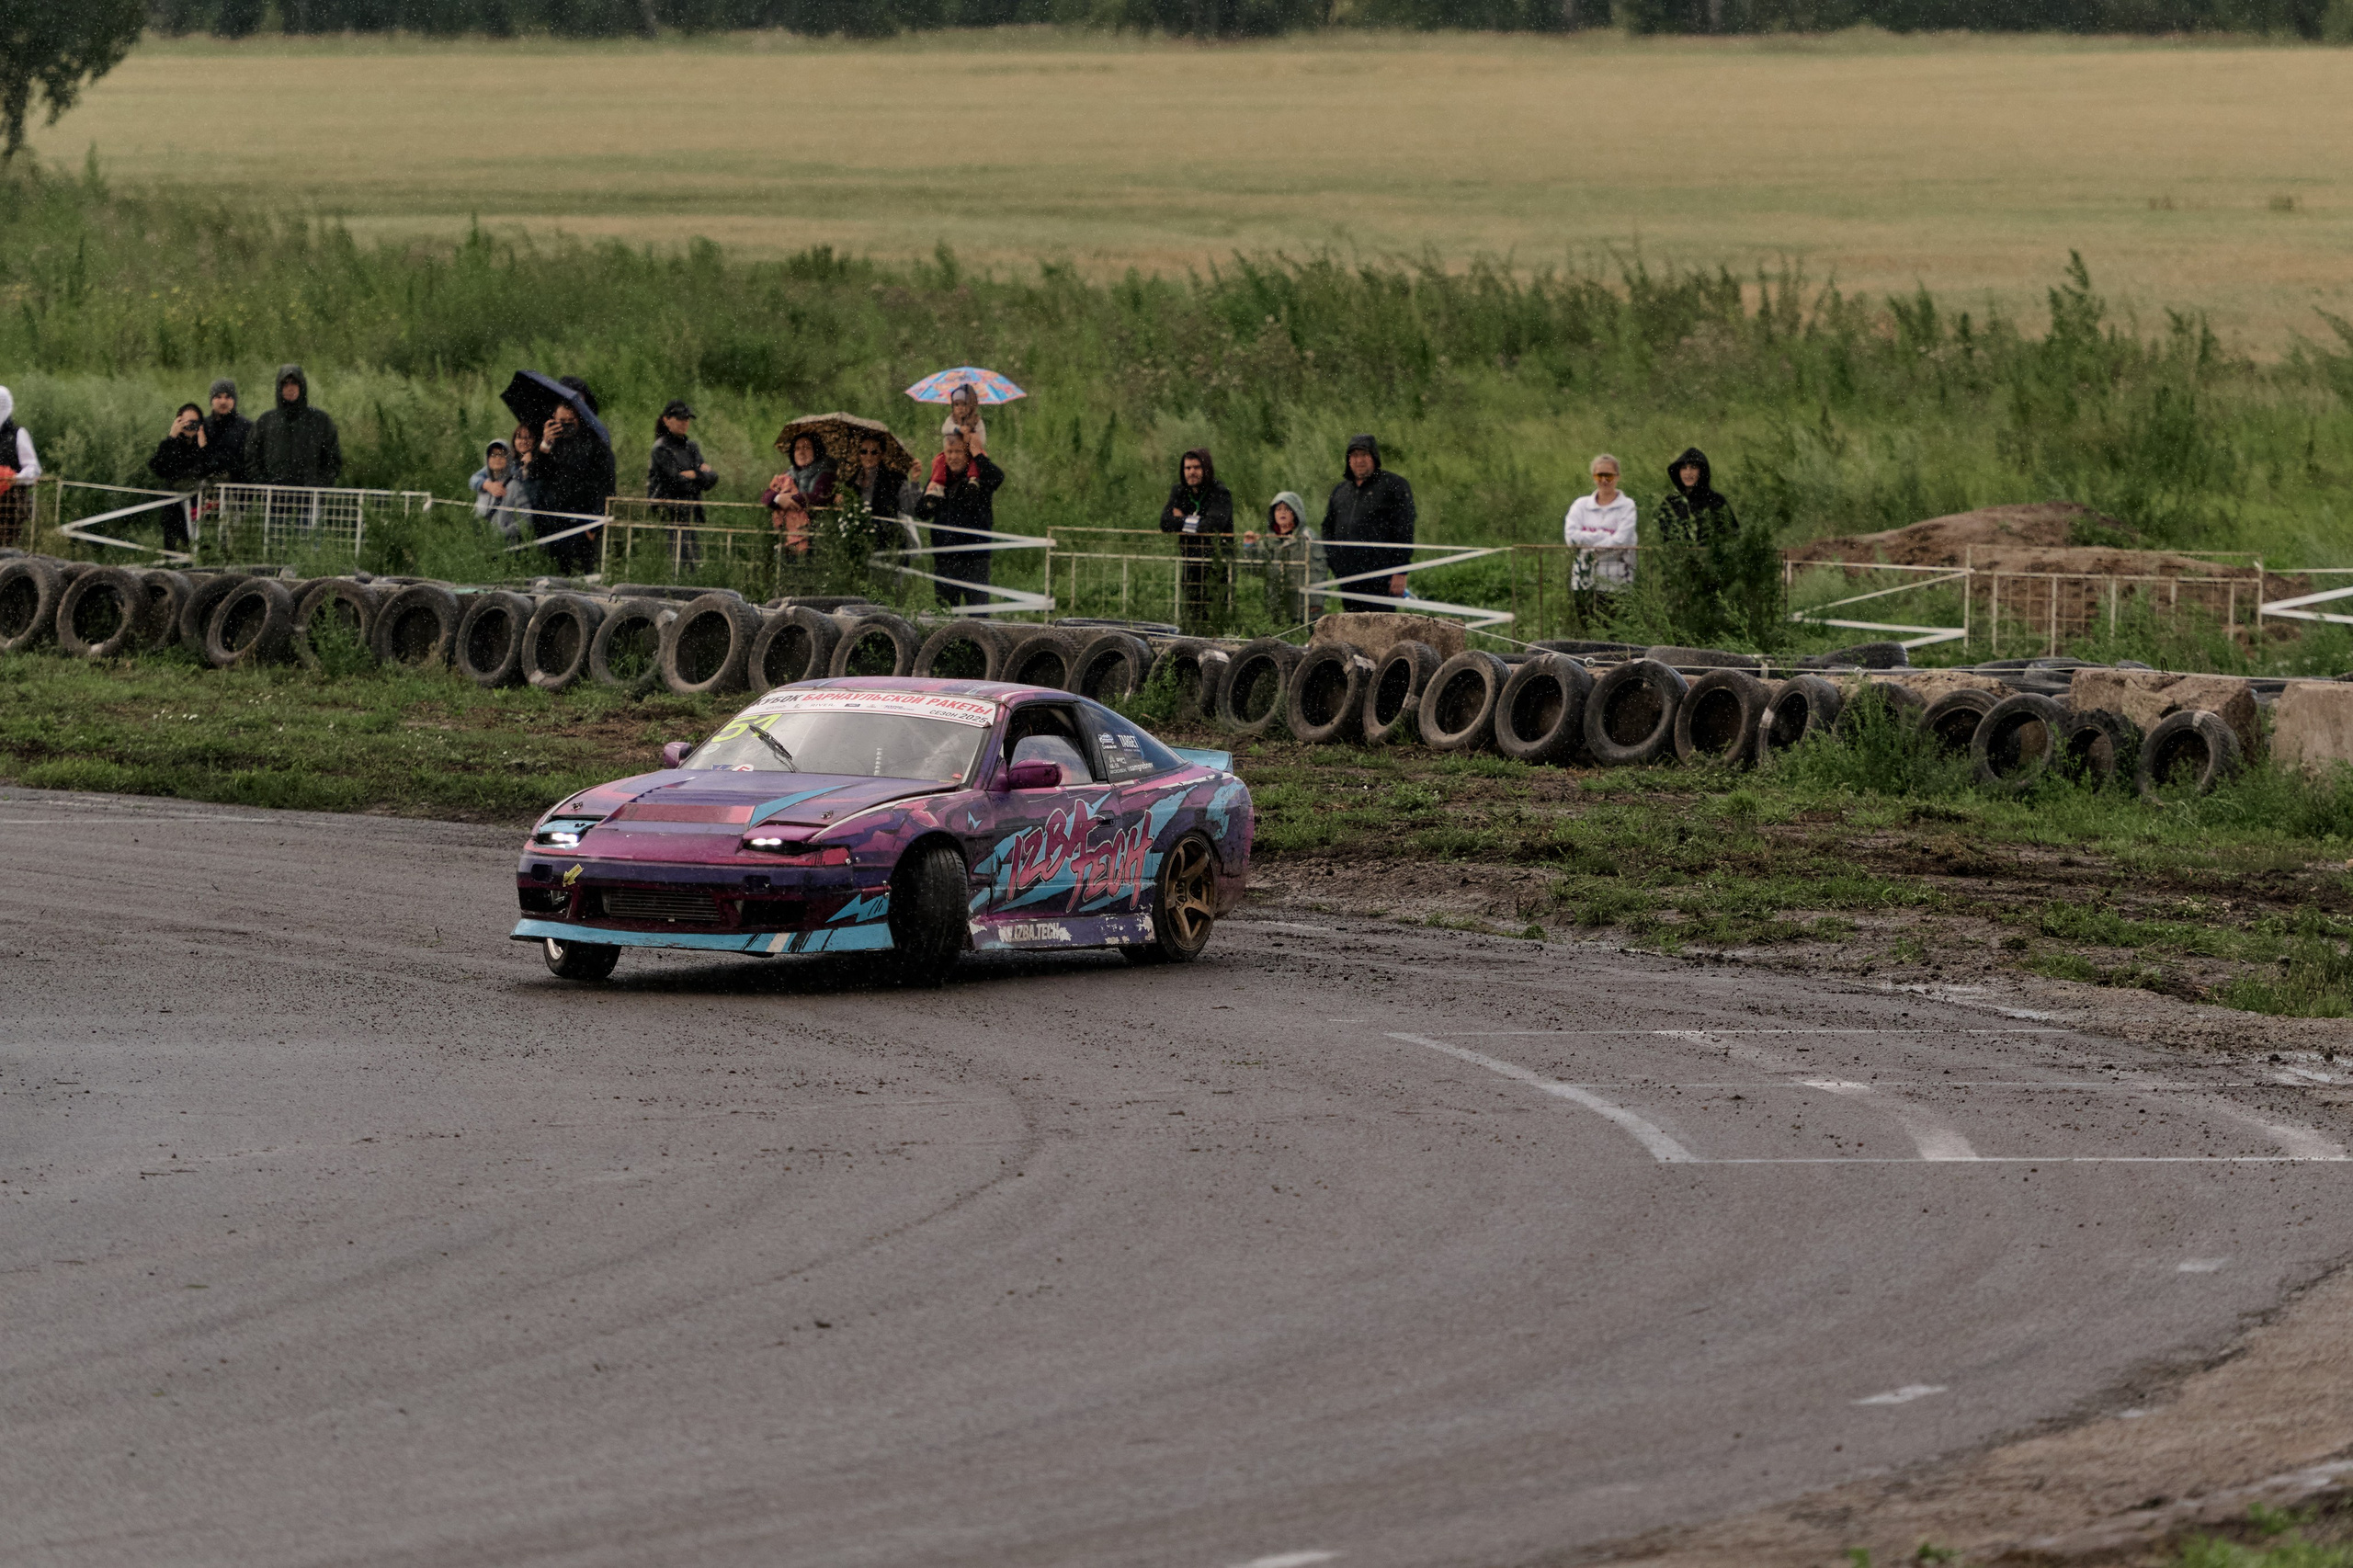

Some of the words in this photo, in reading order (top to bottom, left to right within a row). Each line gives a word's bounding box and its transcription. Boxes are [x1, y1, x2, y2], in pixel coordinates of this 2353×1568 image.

[801, 692, 926, 705] БАРНАУЛЬСКОЙ
[926, 698, 994, 715] РАКЕТЫ
[929, 709, 958, 718] СЕЗОН
[958, 712, 989, 723] 2025
[710, 713, 783, 743] 51
[1116, 734, 1140, 748] TARGET
[1006, 799, 1106, 903] IZBA
[1066, 810, 1154, 913] TECH
